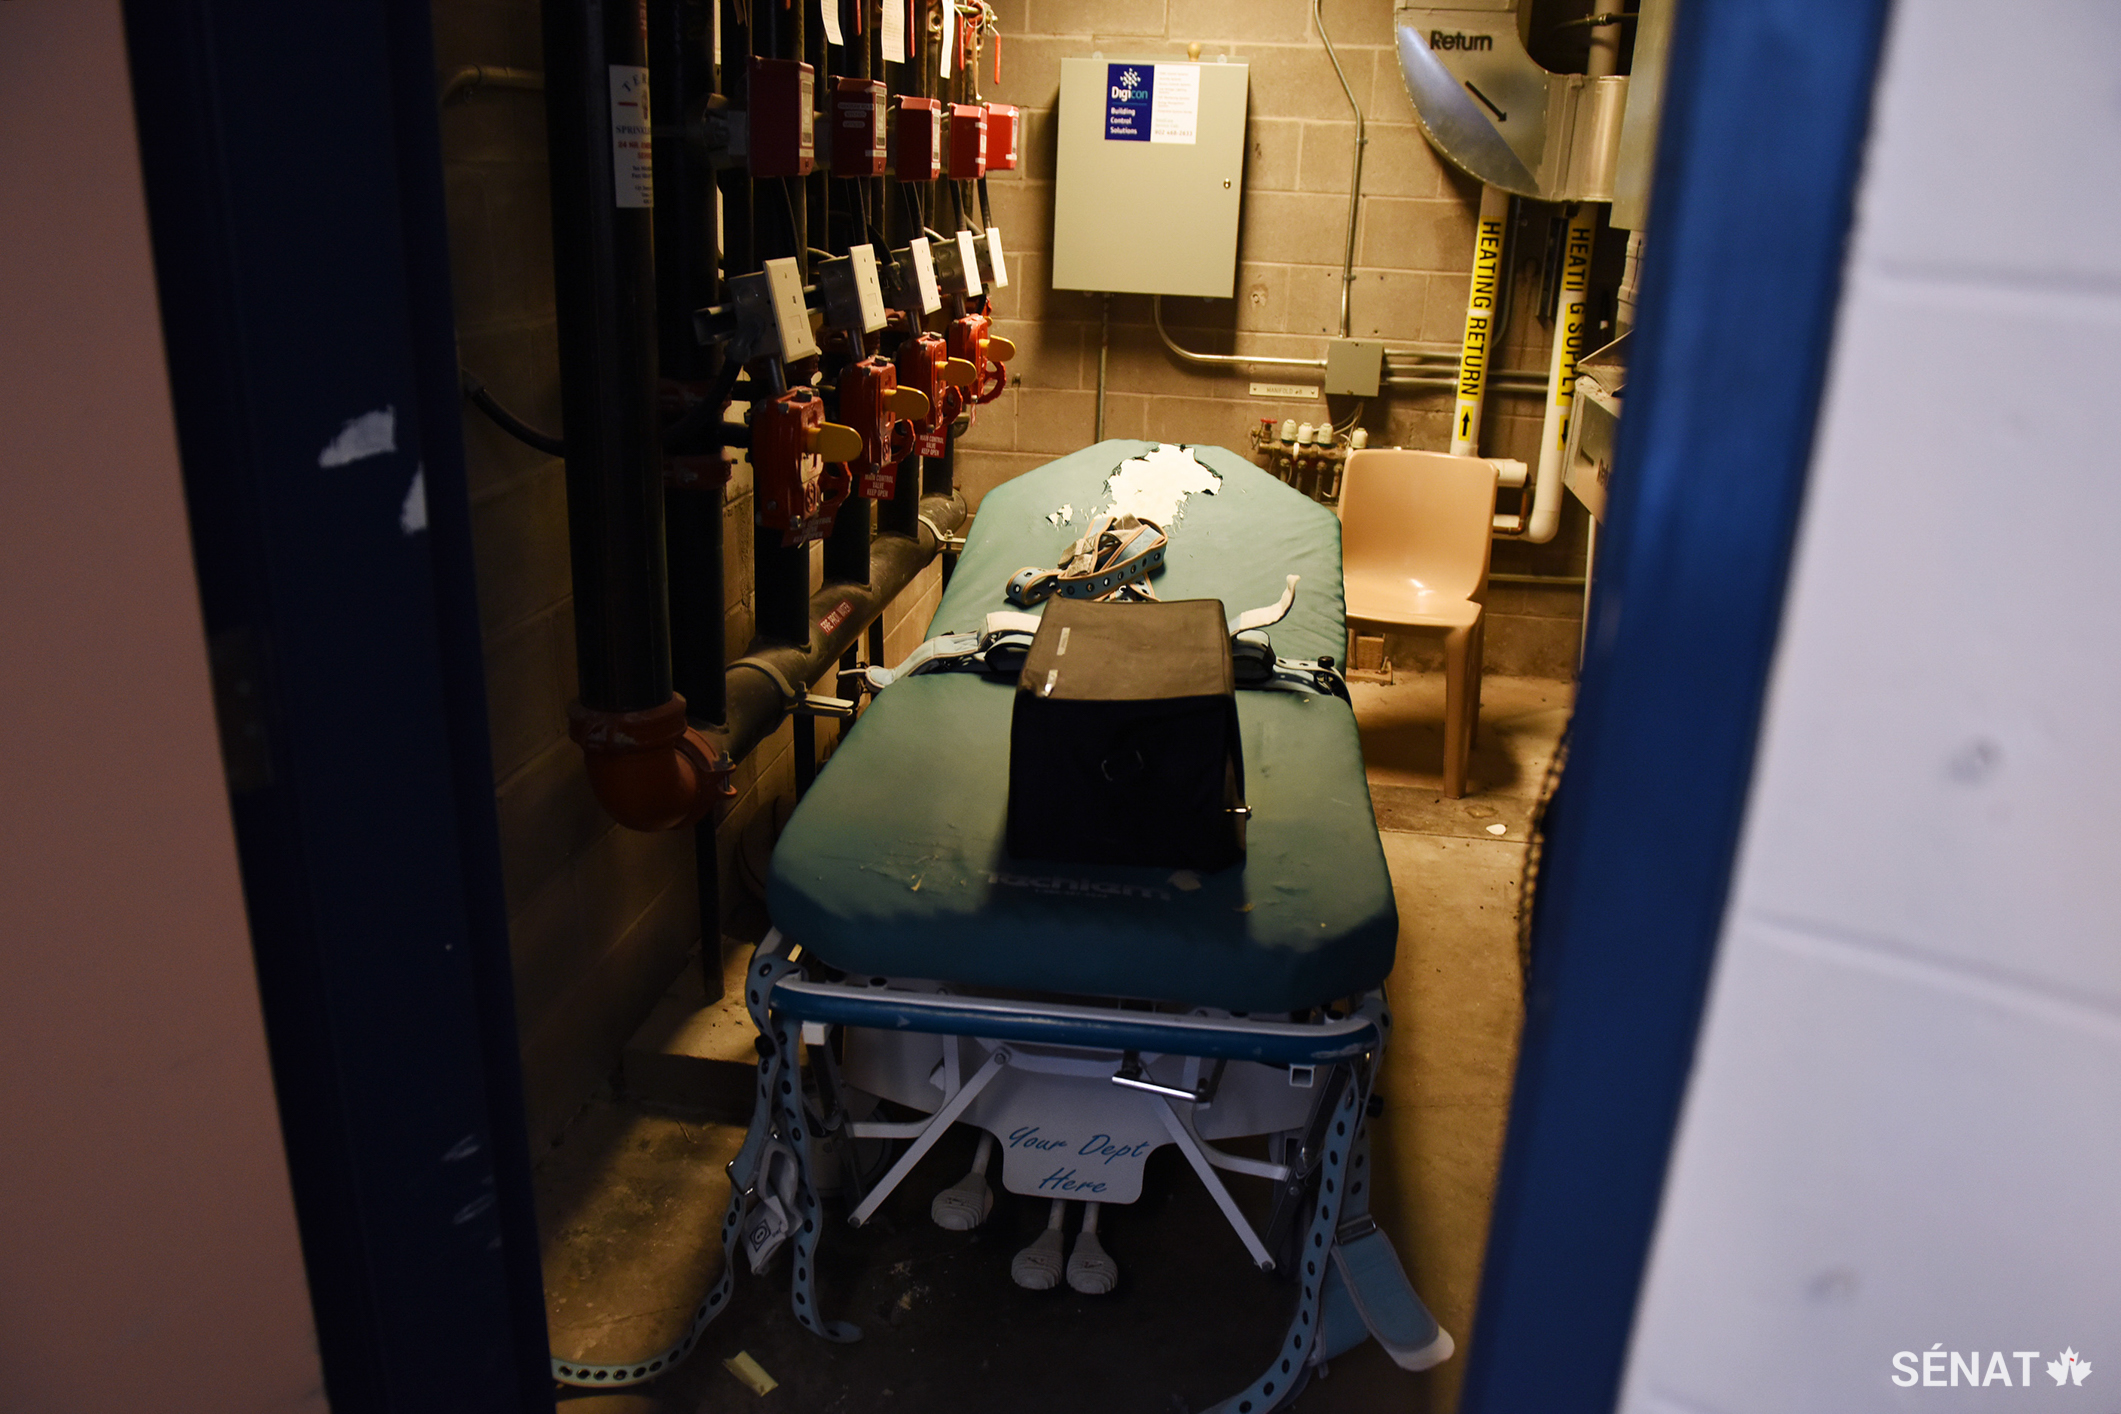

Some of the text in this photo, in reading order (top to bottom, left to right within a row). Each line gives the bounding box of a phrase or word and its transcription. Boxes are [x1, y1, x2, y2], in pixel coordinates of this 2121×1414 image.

[1430, 30, 1493, 51] Return
[1111, 86, 1148, 102] Digicon
[1109, 116, 1132, 125] Control
[1110, 107, 1136, 117] Building
[1109, 126, 1138, 135] Solutions
[1461, 222, 1501, 396] HEATING RETURN
[1009, 1126, 1150, 1165] Your Dept
[1038, 1167, 1107, 1193] Here
